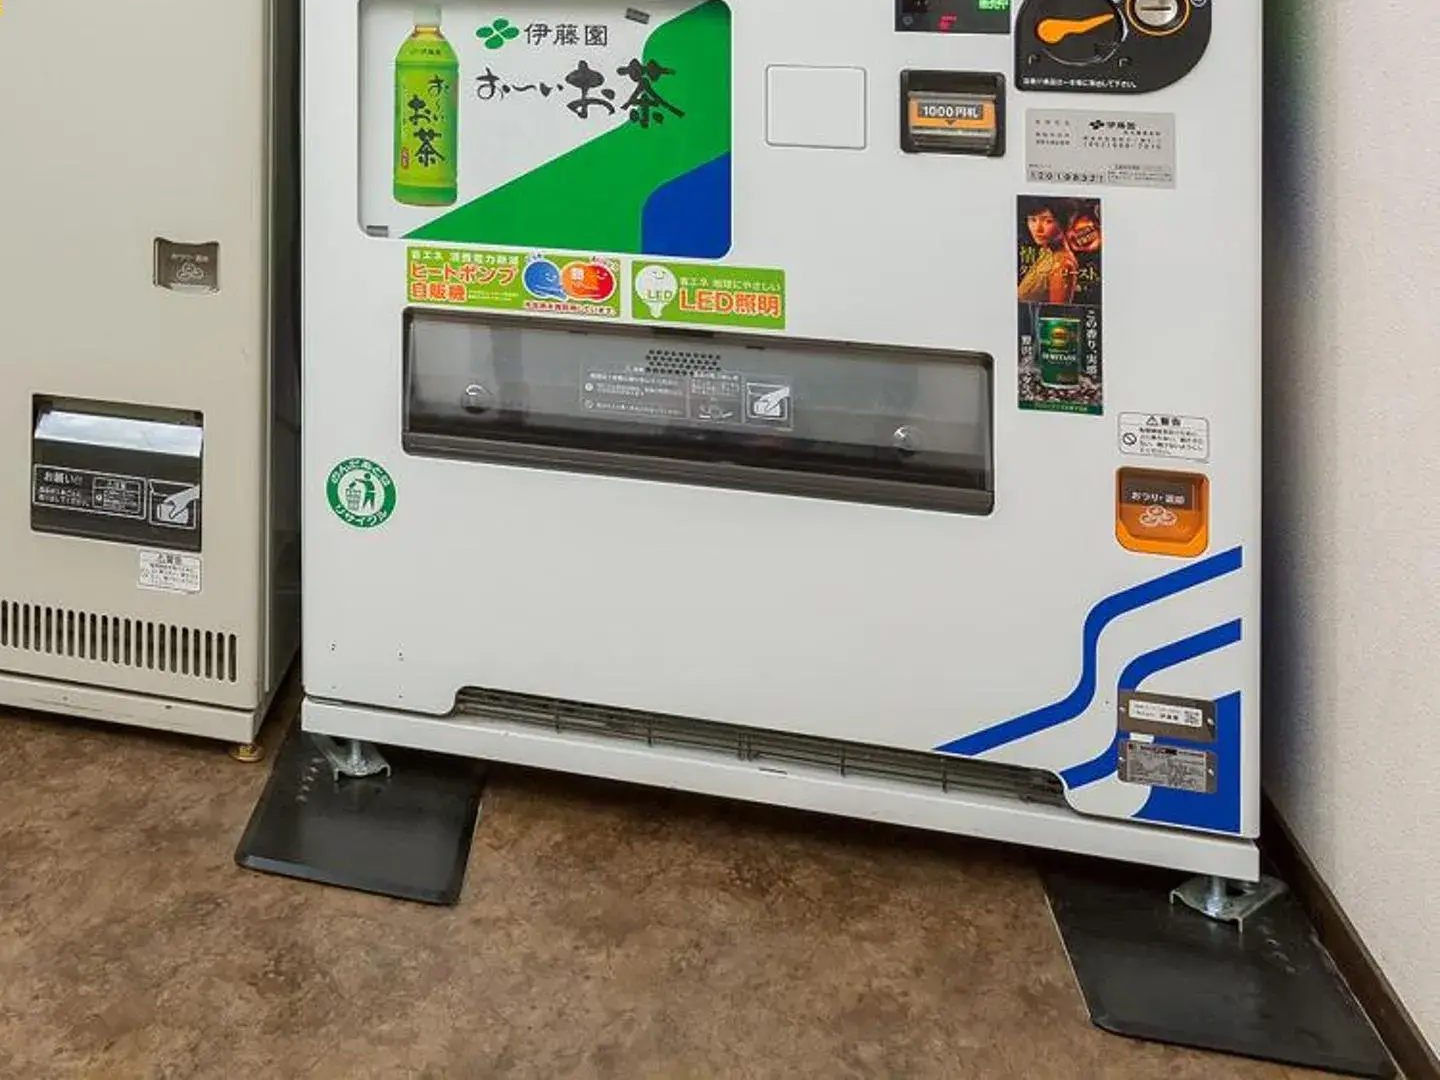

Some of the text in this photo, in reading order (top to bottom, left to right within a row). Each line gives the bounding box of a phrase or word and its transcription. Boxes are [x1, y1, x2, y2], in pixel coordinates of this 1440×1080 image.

[524, 23, 608, 48] 伊藤園
[407, 94, 445, 167] お茶
[409, 261, 519, 286] ヒートポンプ
[410, 282, 467, 303] 自販機
[679, 287, 782, 318] LED照明
